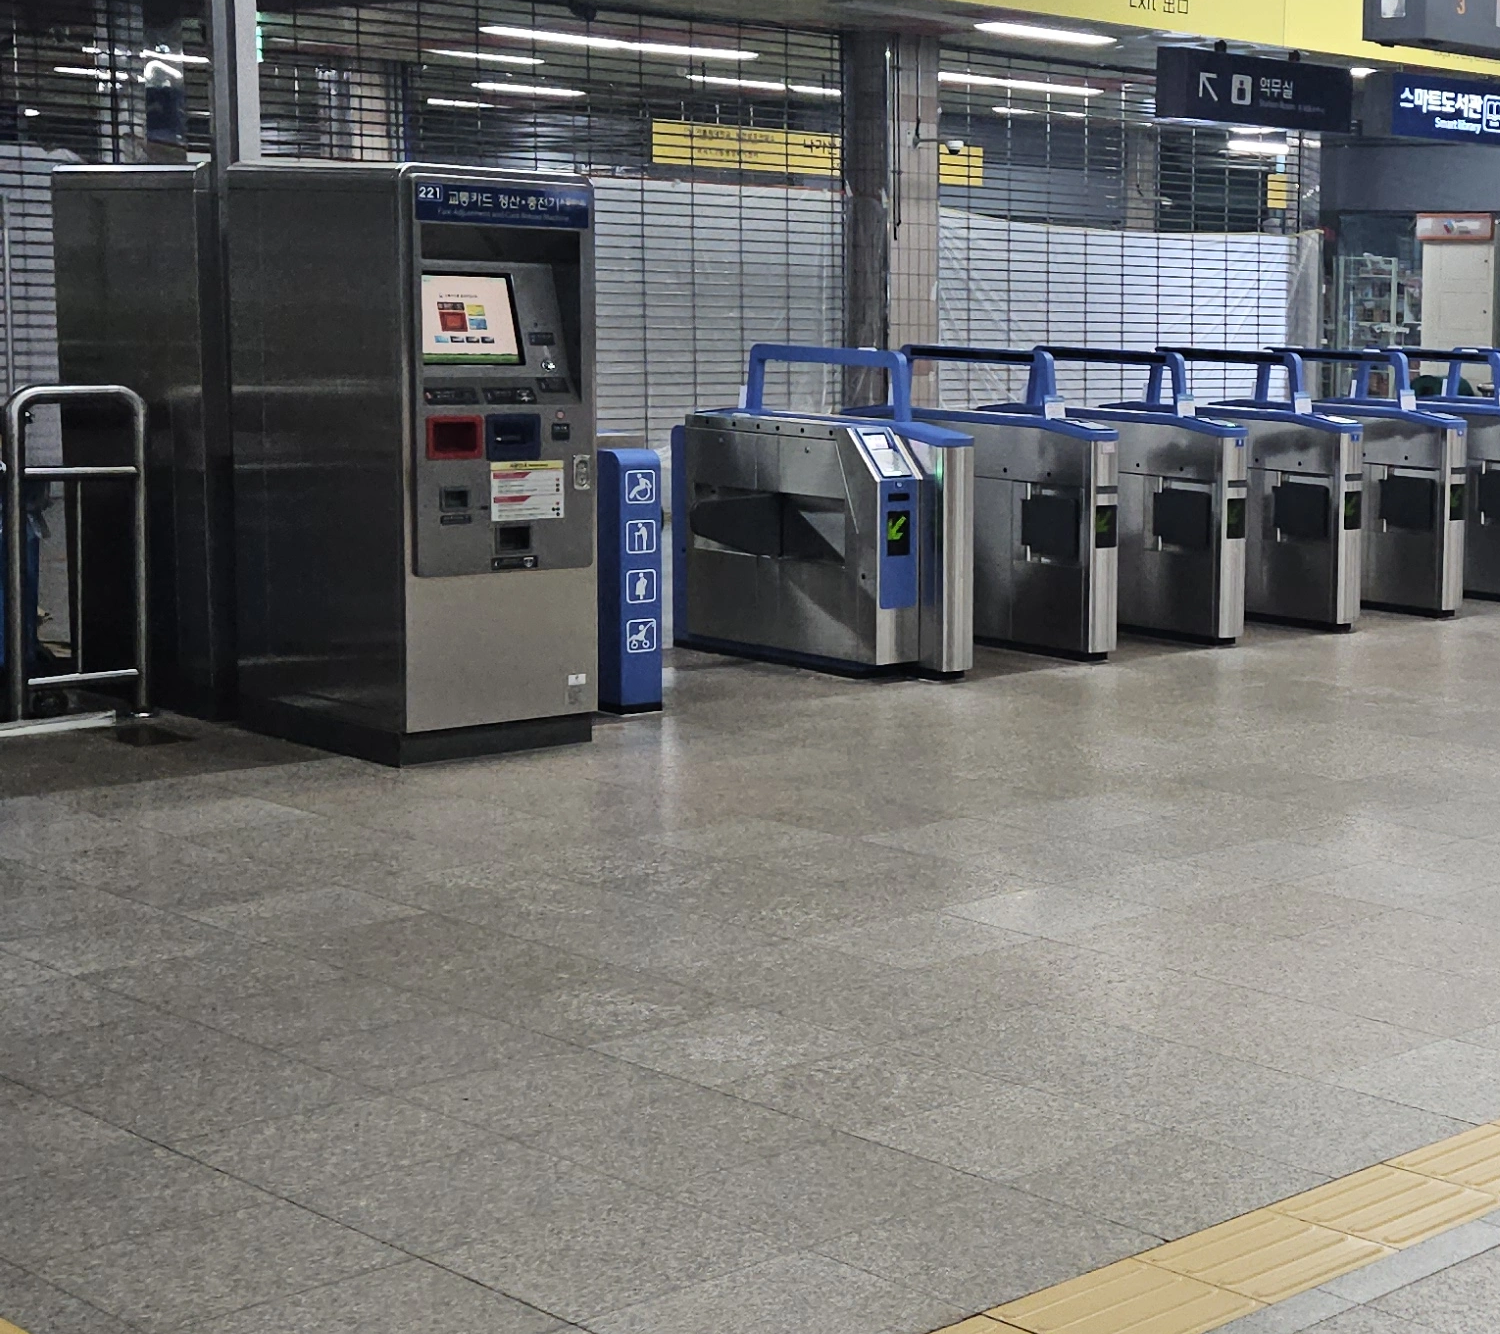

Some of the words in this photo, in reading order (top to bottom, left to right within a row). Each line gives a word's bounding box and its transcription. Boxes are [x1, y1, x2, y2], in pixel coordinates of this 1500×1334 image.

[1260, 77, 1293, 99] 역무실
[1399, 87, 1484, 119] 스마트도서관
[418, 186, 441, 199] 221
[448, 191, 494, 207] 교통카드
